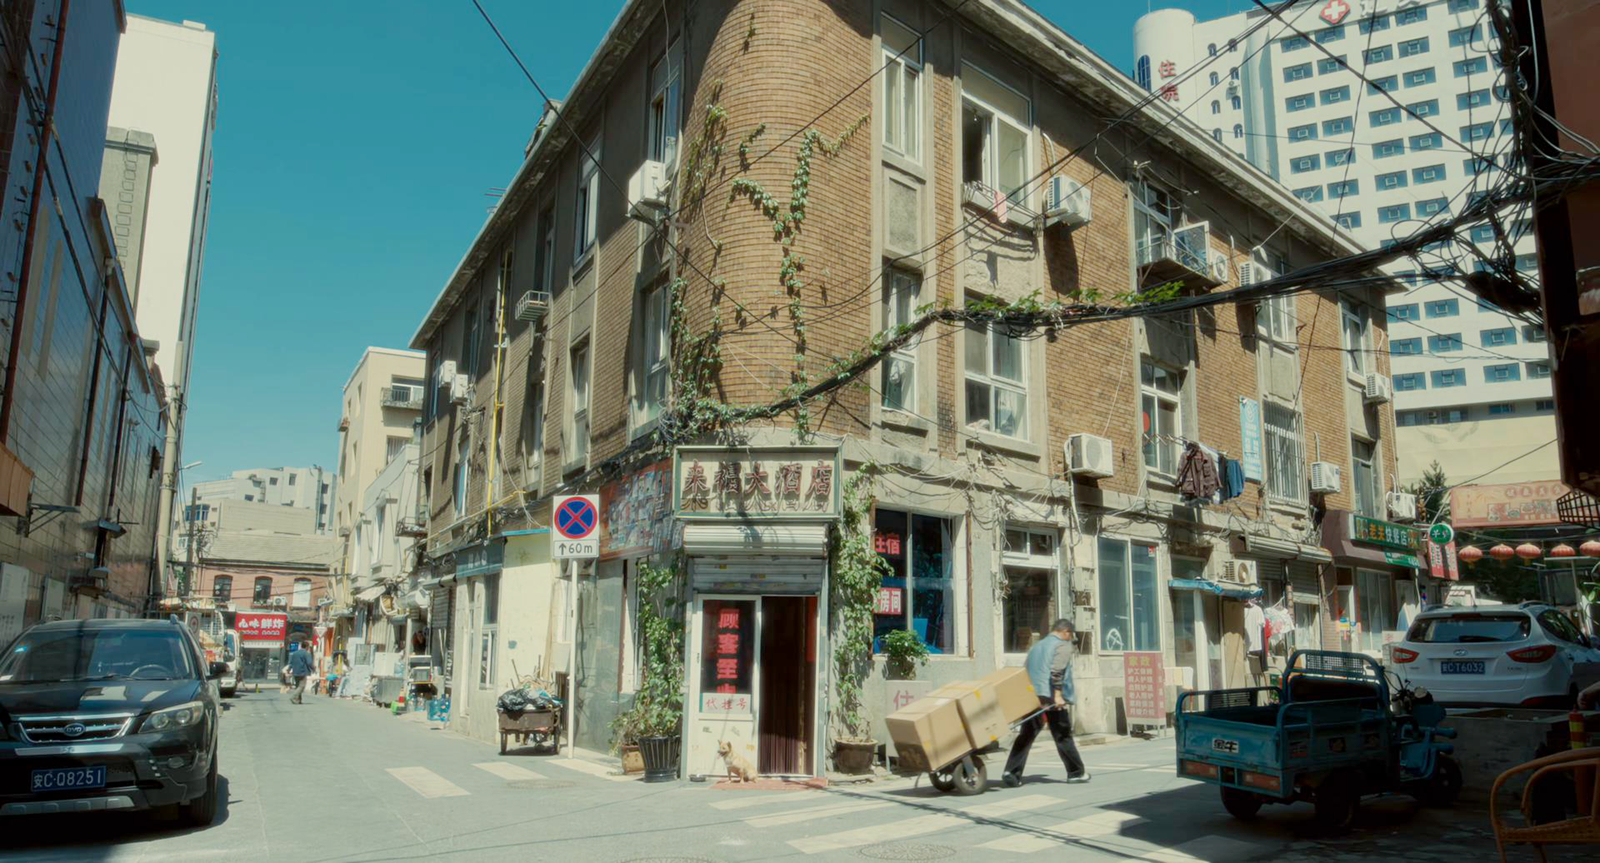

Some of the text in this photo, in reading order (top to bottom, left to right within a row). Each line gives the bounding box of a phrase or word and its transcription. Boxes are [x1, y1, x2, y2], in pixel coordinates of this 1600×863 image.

[683, 459, 833, 495] 来福大酒店
[568, 543, 594, 555] 60m
[872, 589, 901, 612] 房间
[705, 697, 748, 711] 代挂号
